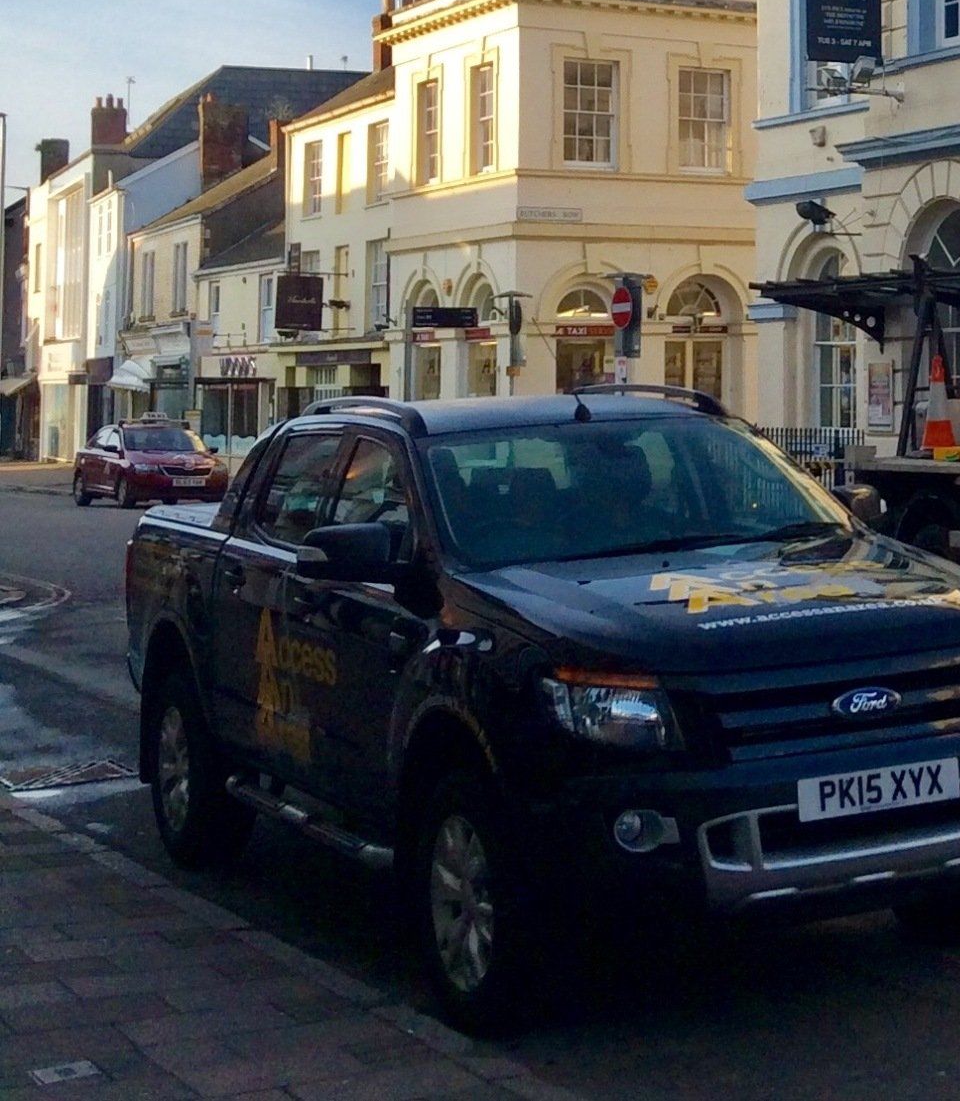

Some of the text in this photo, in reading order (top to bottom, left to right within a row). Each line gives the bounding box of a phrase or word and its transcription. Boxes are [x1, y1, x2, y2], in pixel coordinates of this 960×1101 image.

[567, 327, 587, 335] TAXI
[849, 691, 888, 713] Ford
[818, 764, 944, 812] PK15 XYX
